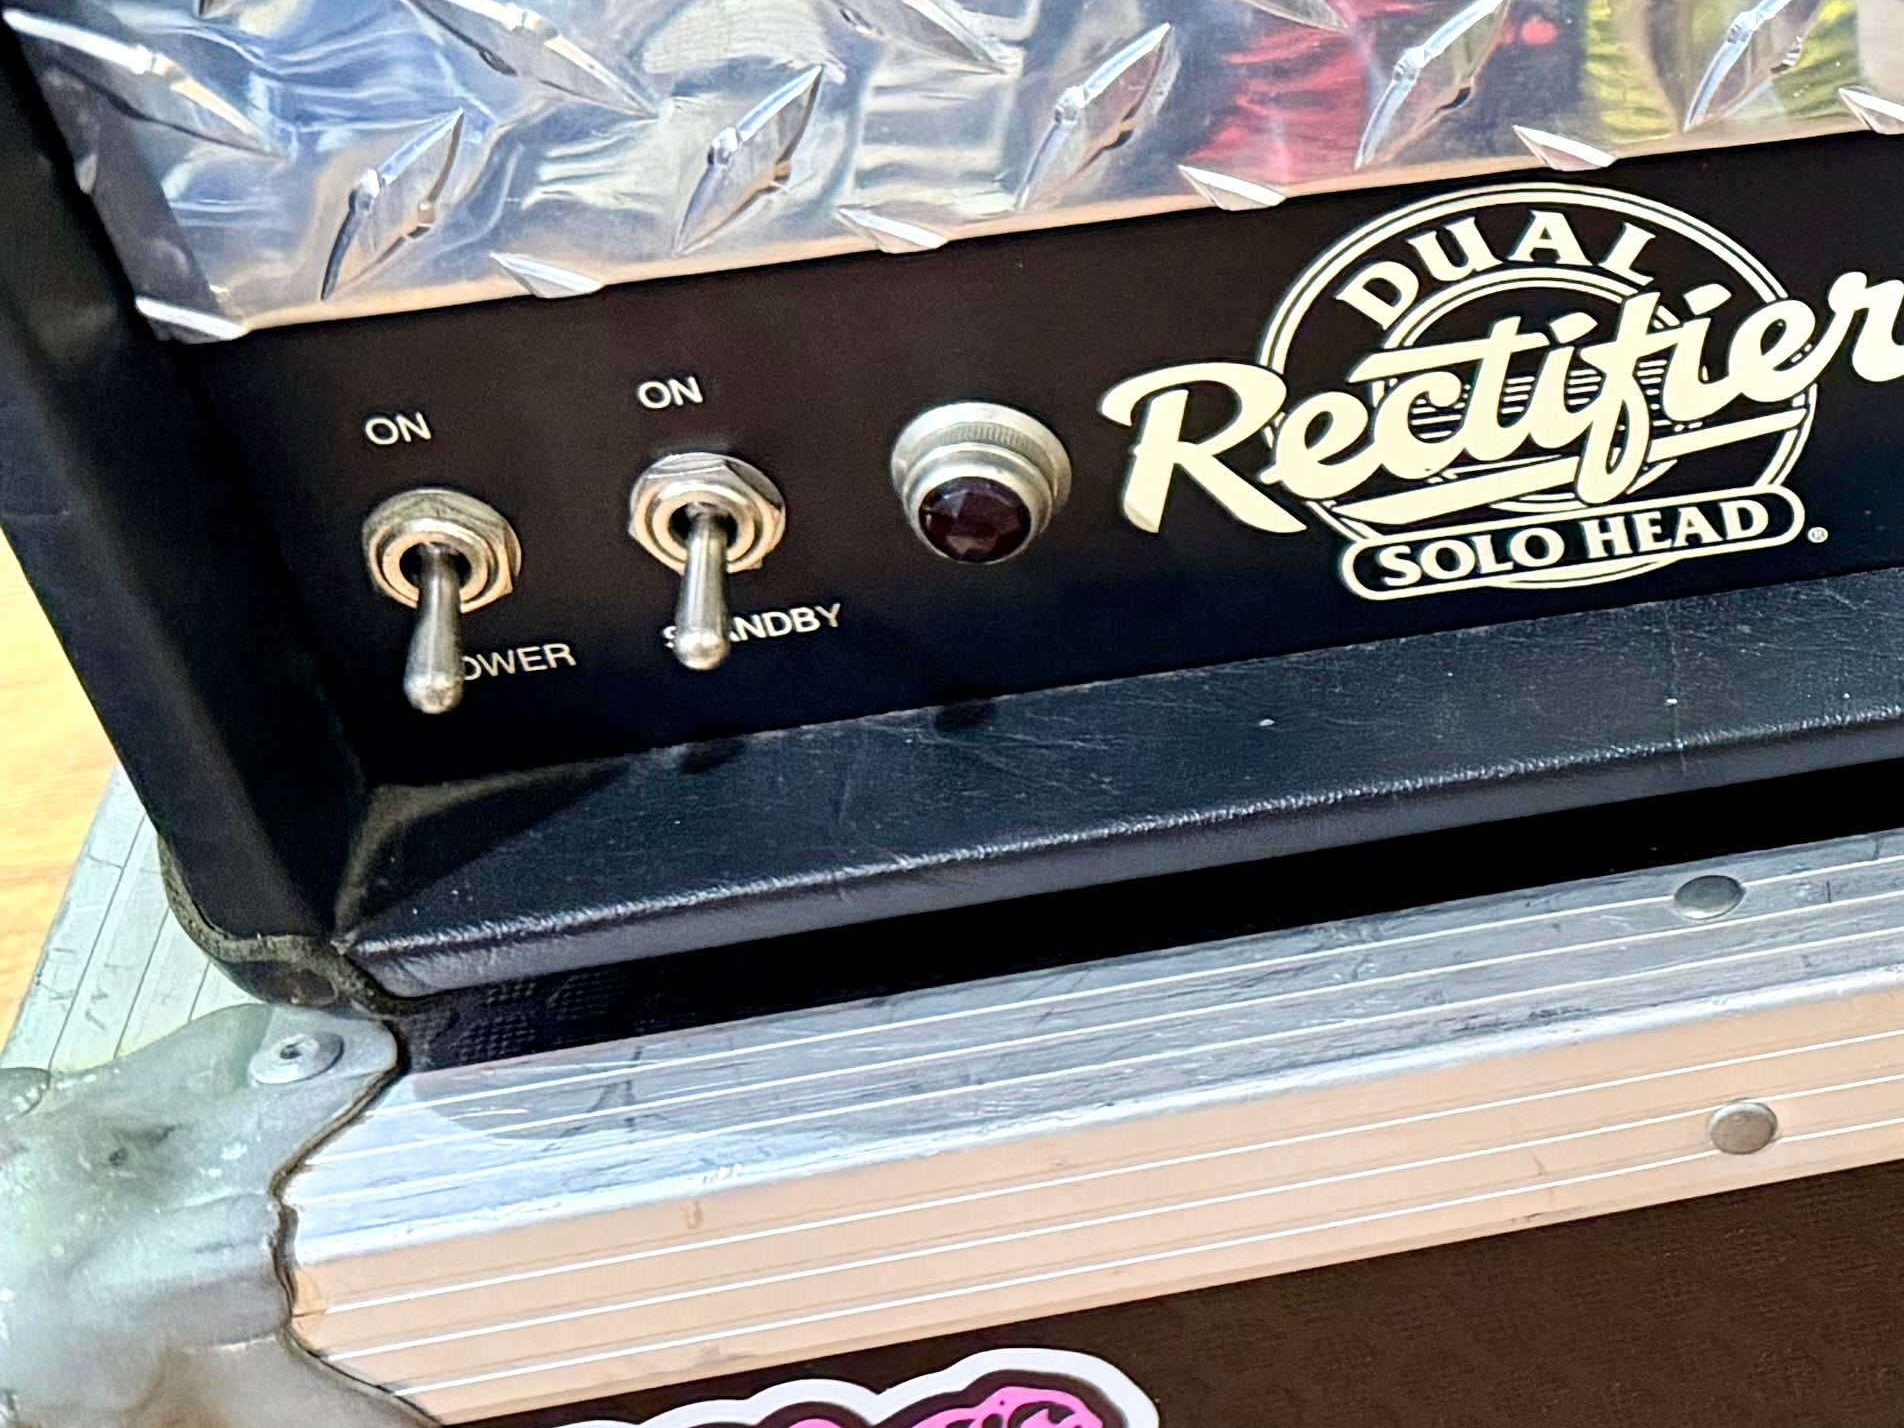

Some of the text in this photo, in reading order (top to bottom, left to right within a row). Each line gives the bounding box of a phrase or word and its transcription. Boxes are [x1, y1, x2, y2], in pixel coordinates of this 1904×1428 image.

[1334, 209, 1657, 330] DUAL
[638, 376, 703, 410] ON
[364, 411, 432, 446] ON
[1380, 497, 1769, 587] SOLO HEAD
[461, 642, 577, 681] OWER
